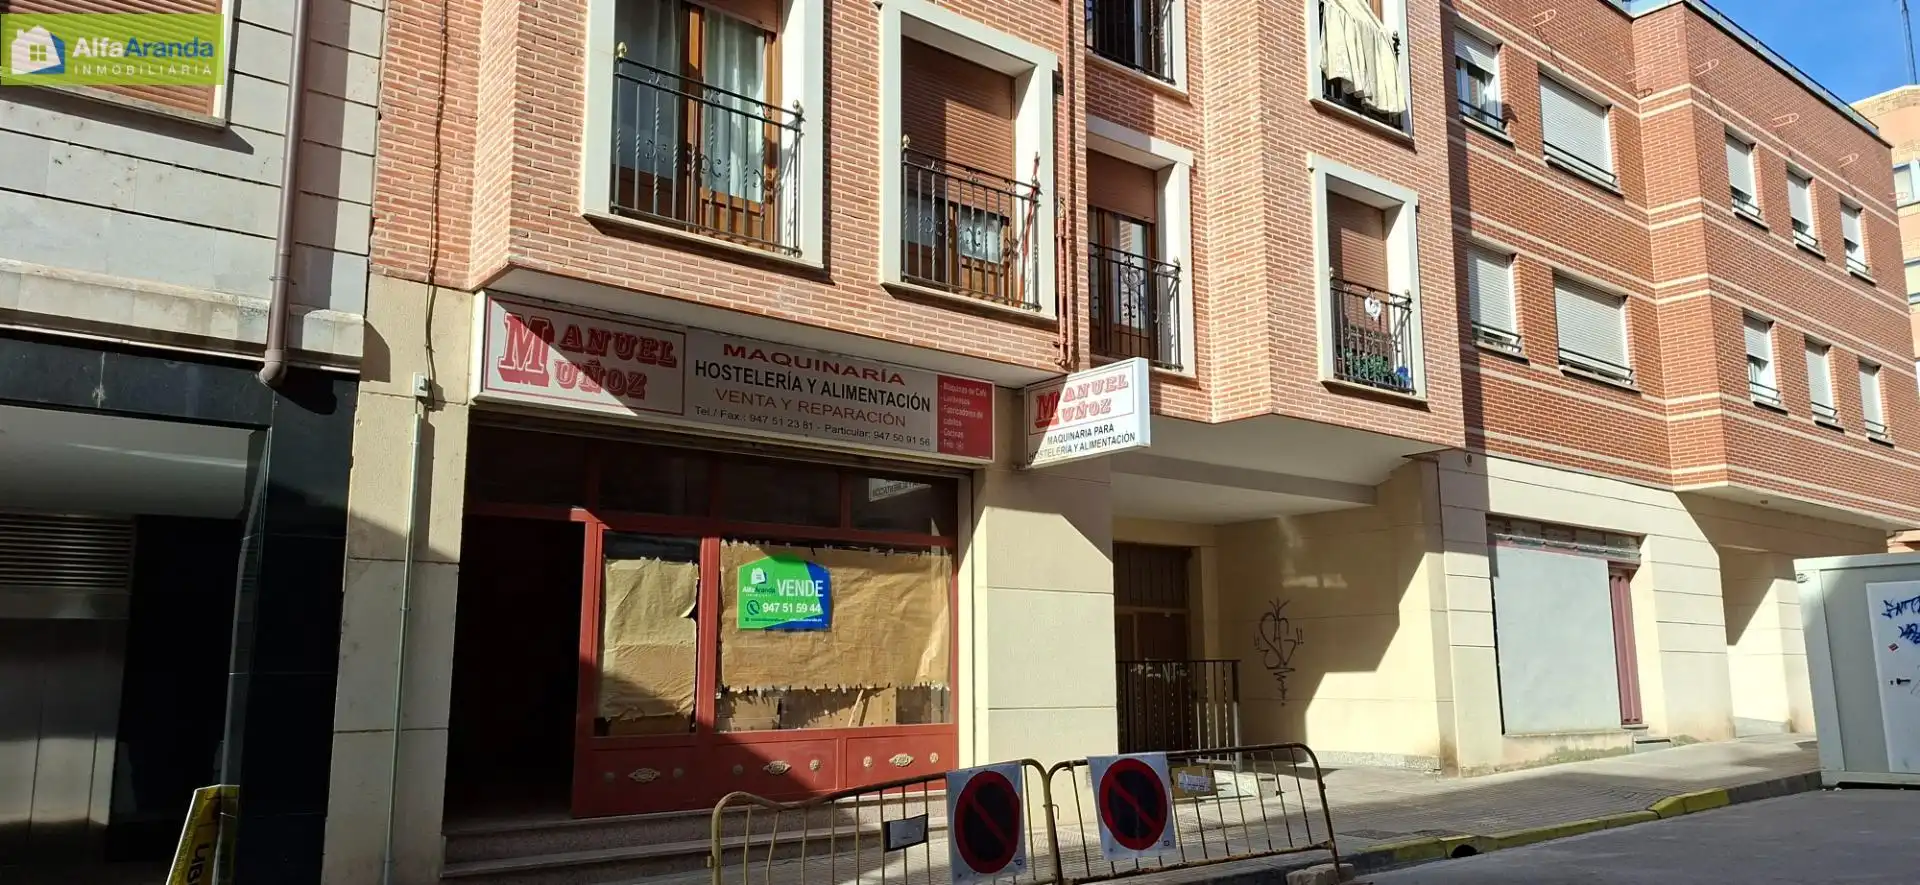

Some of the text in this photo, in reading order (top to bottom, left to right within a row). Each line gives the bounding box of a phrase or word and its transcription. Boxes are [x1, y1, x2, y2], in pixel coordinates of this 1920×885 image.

[498, 311, 677, 388] MANUEL
[695, 360, 931, 412] HOSTELERÍA Y ALIMENTACIÓN
[715, 387, 906, 427] VENTA Y REPARACIÓN
[1034, 374, 1129, 428] MANUEL
[750, 414, 768, 424] 947
[772, 416, 783, 426] 51
[787, 418, 800, 429] 23
[873, 430, 890, 441] 947
[1093, 423, 1115, 437] PARA
[1073, 443, 1080, 453] Y
[1079, 430, 1135, 452] ALIMENTACIÓN
[776, 579, 823, 597] VENDE
[762, 602, 821, 613] 947 51 59 44
